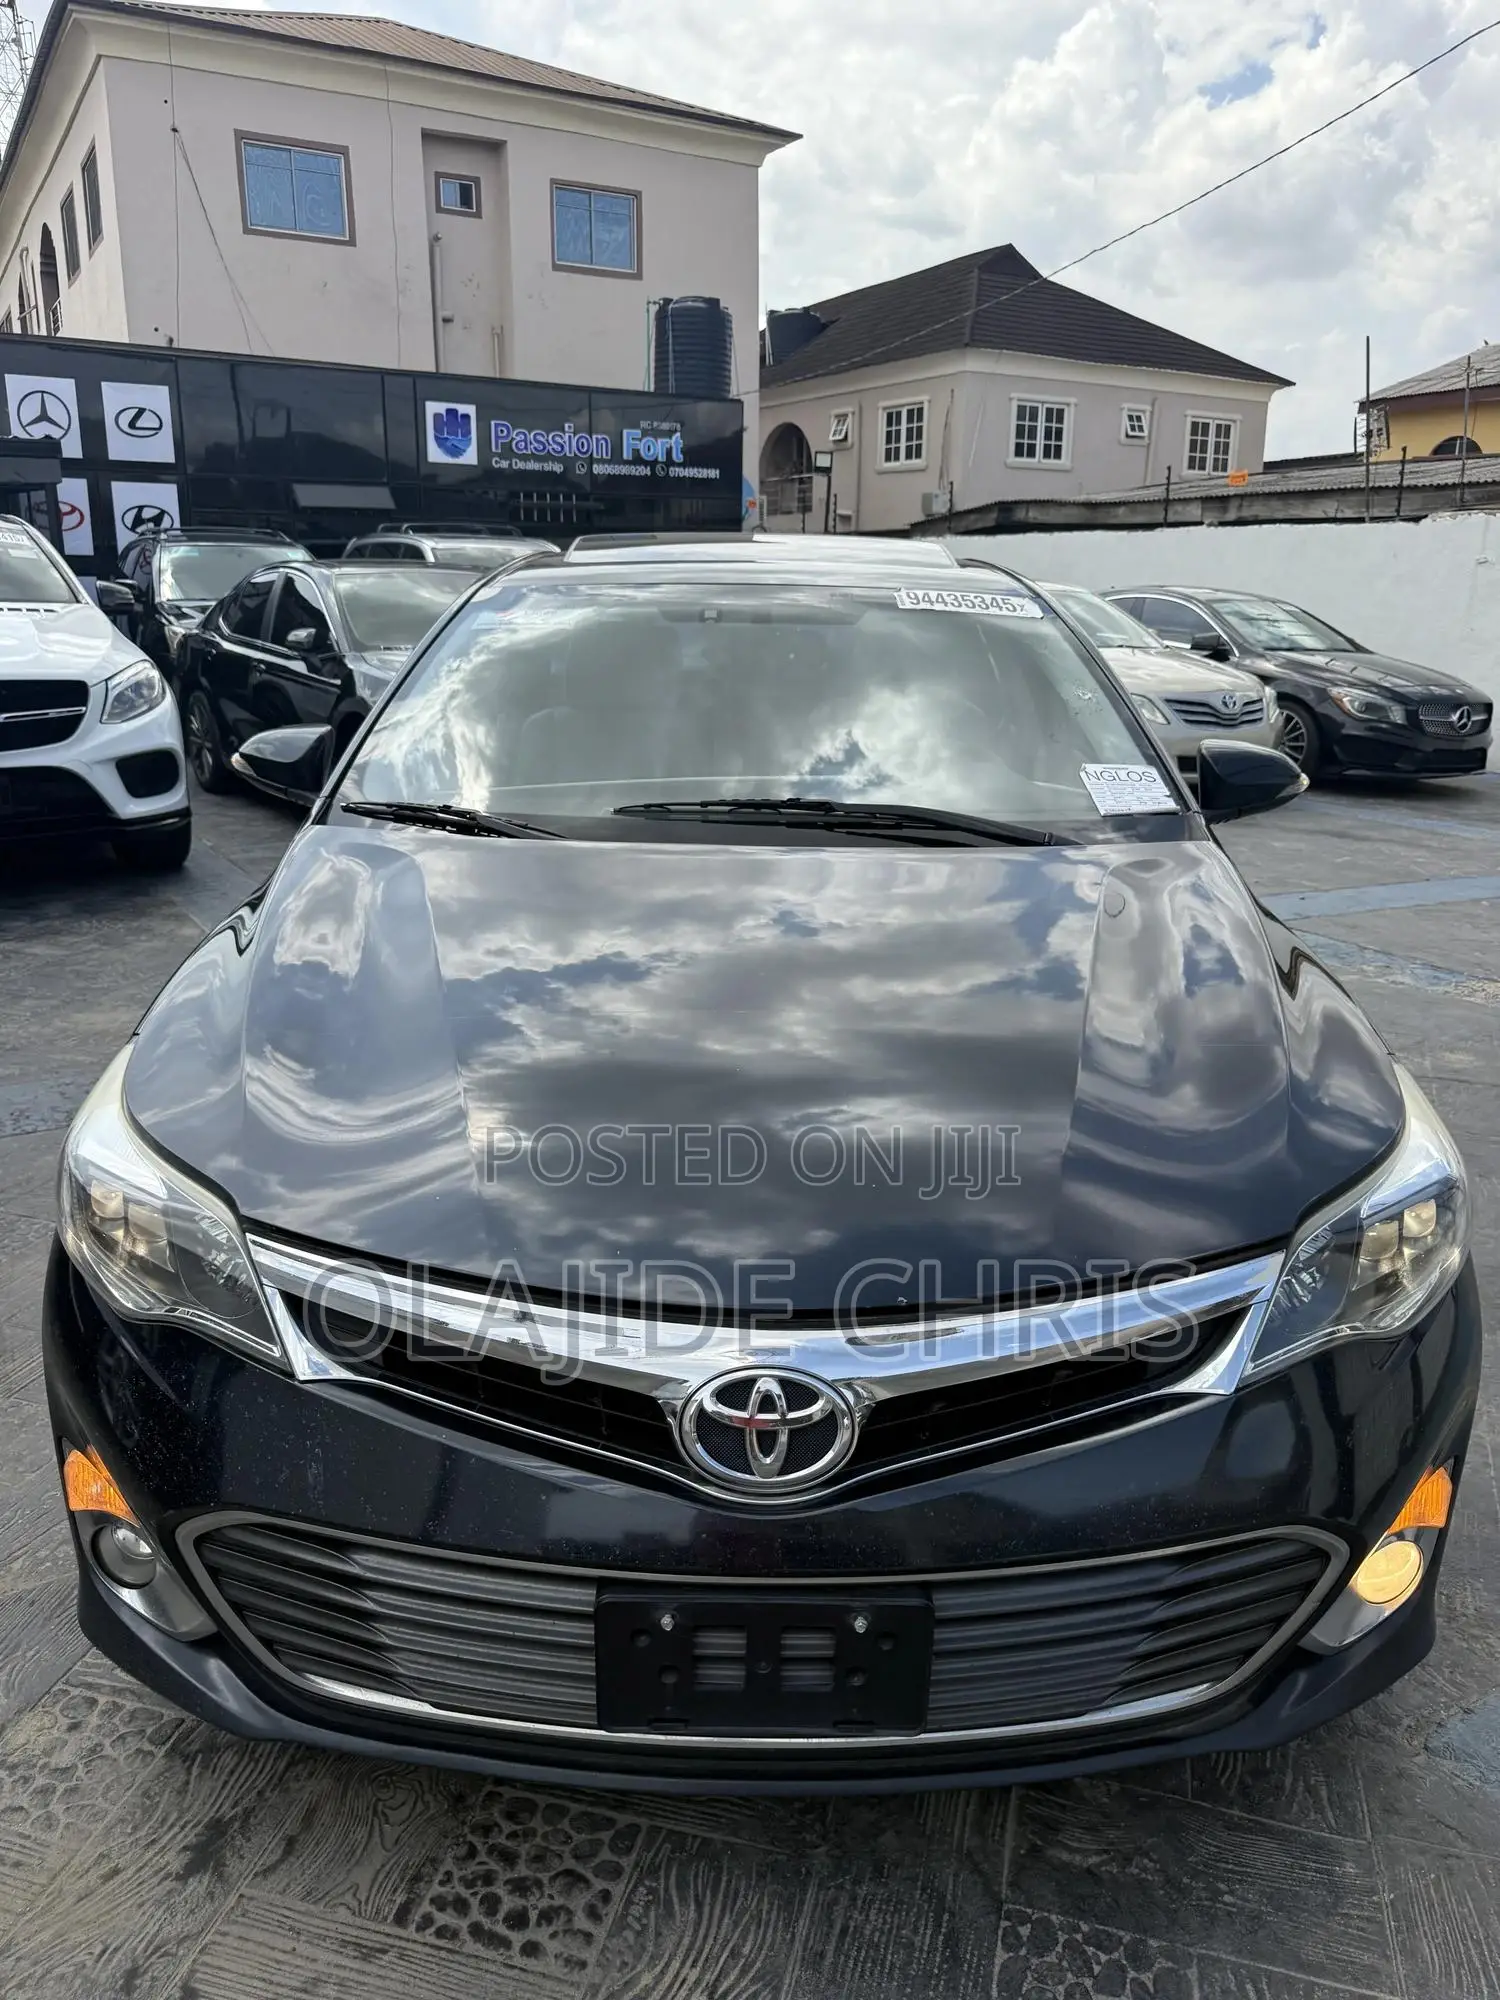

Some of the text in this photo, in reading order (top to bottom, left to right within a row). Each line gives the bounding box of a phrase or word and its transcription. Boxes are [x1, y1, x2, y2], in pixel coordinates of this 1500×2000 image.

[491, 420, 684, 463] Passion Fort
[492, 458, 510, 469] Car
[512, 459, 564, 474] Dealership
[1084, 770, 1157, 783] NGLOS
